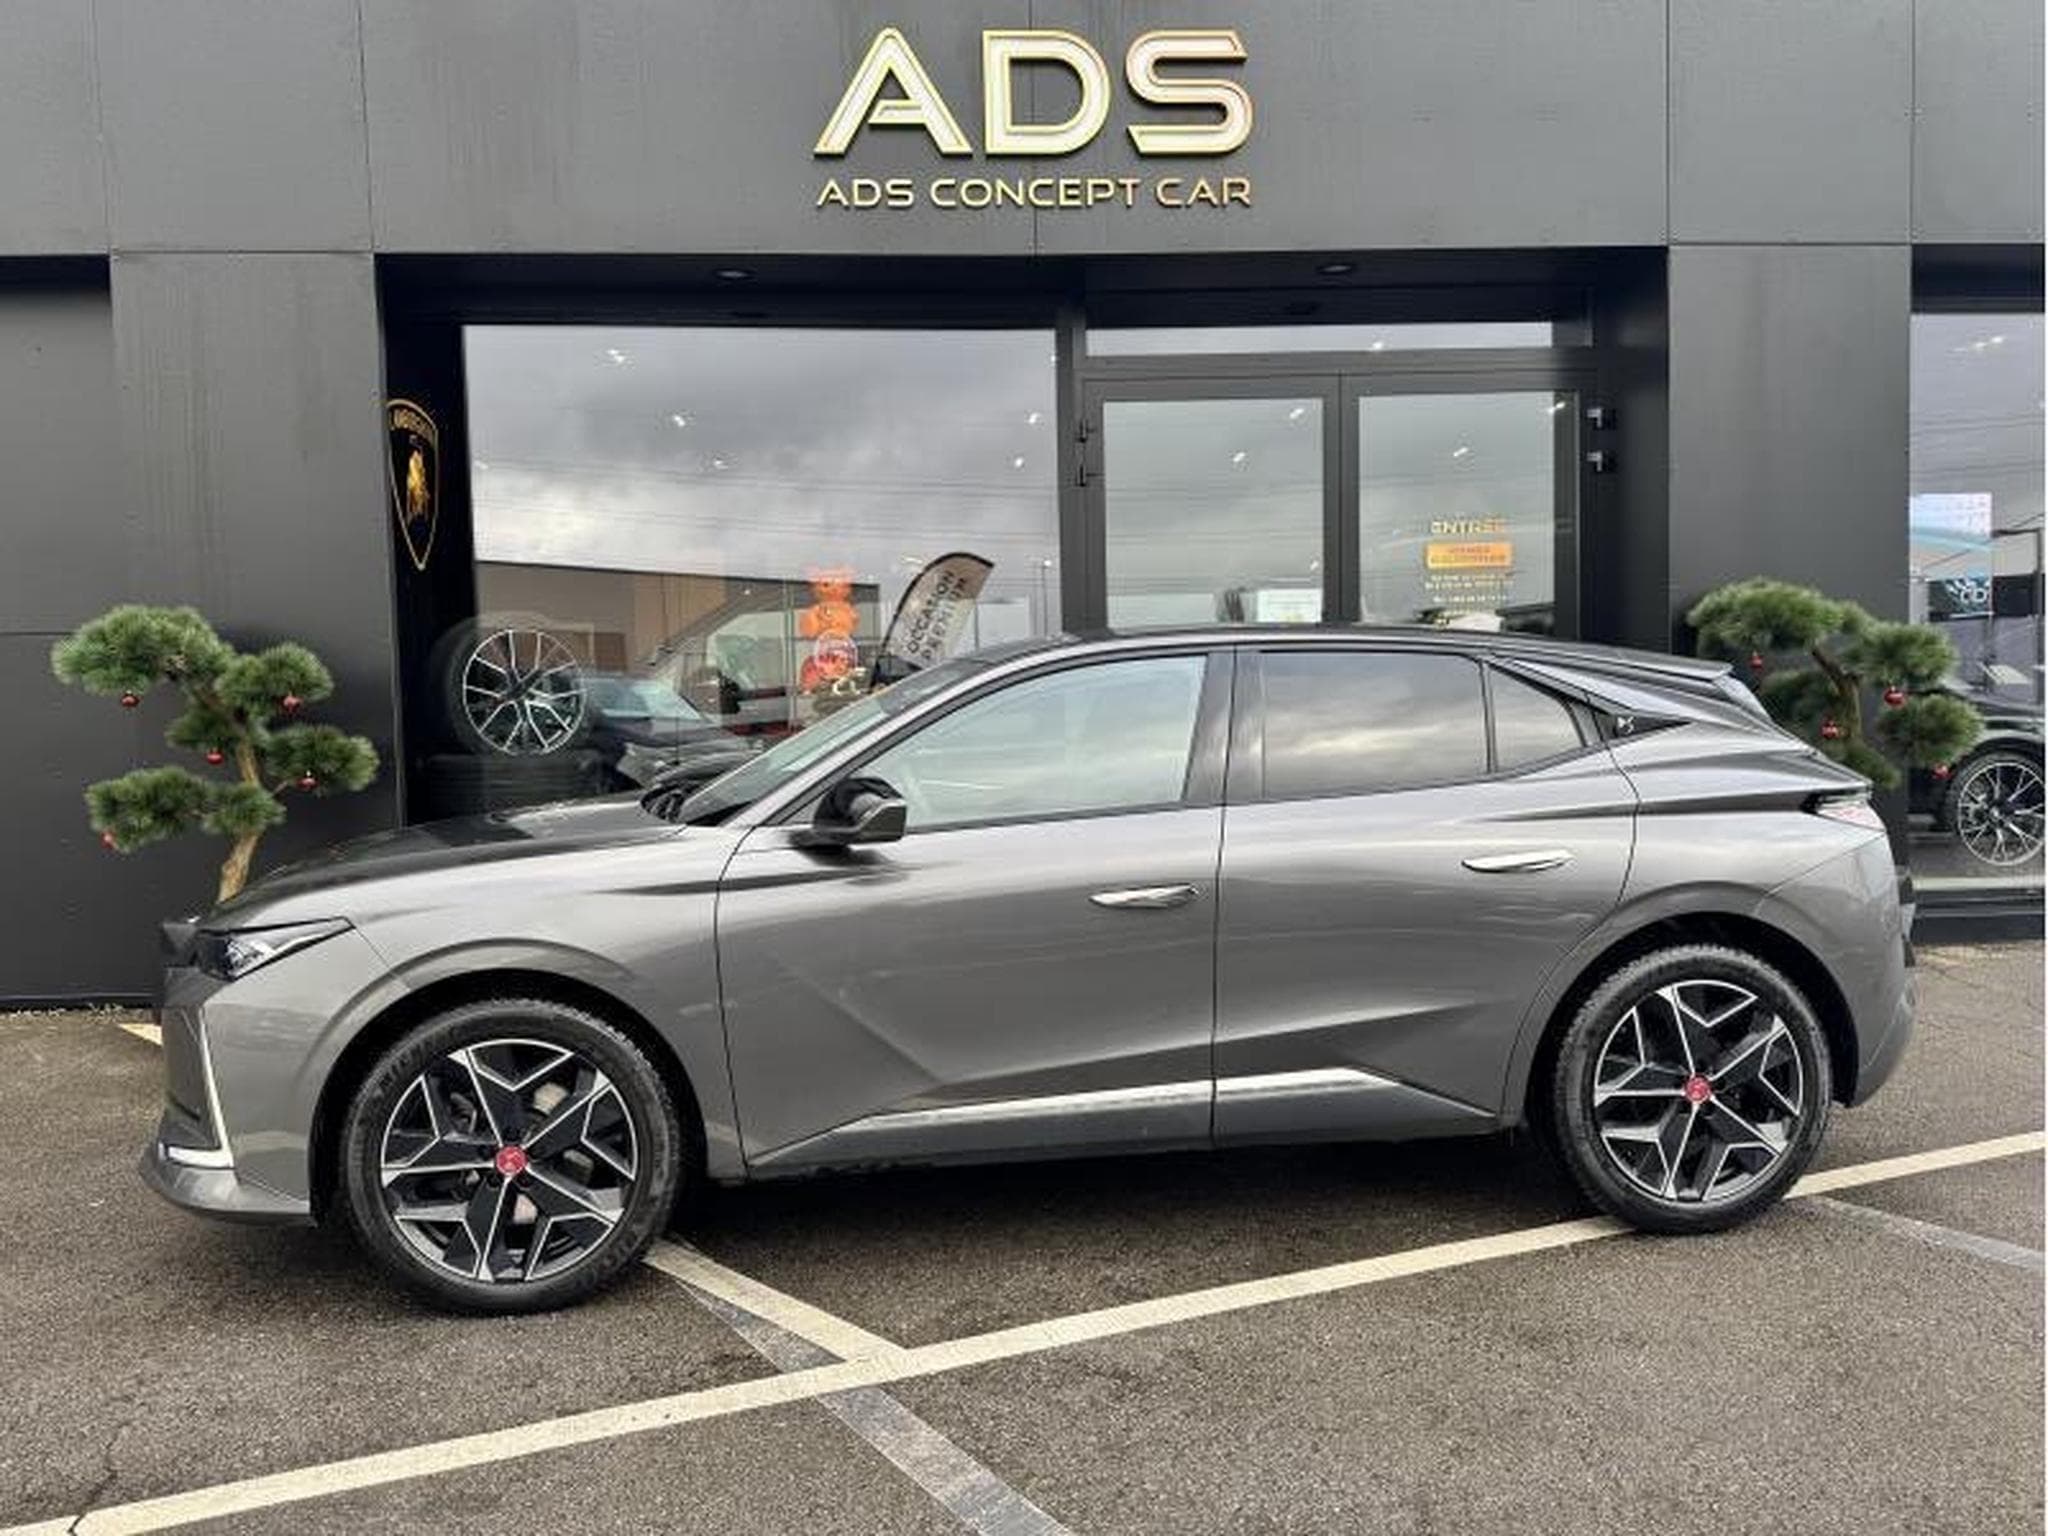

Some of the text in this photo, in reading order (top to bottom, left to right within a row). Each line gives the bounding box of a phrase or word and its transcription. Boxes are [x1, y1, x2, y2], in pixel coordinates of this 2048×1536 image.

[814, 27, 1253, 155] ADS
[816, 178, 1253, 208] ADS CONCEPT CAR
